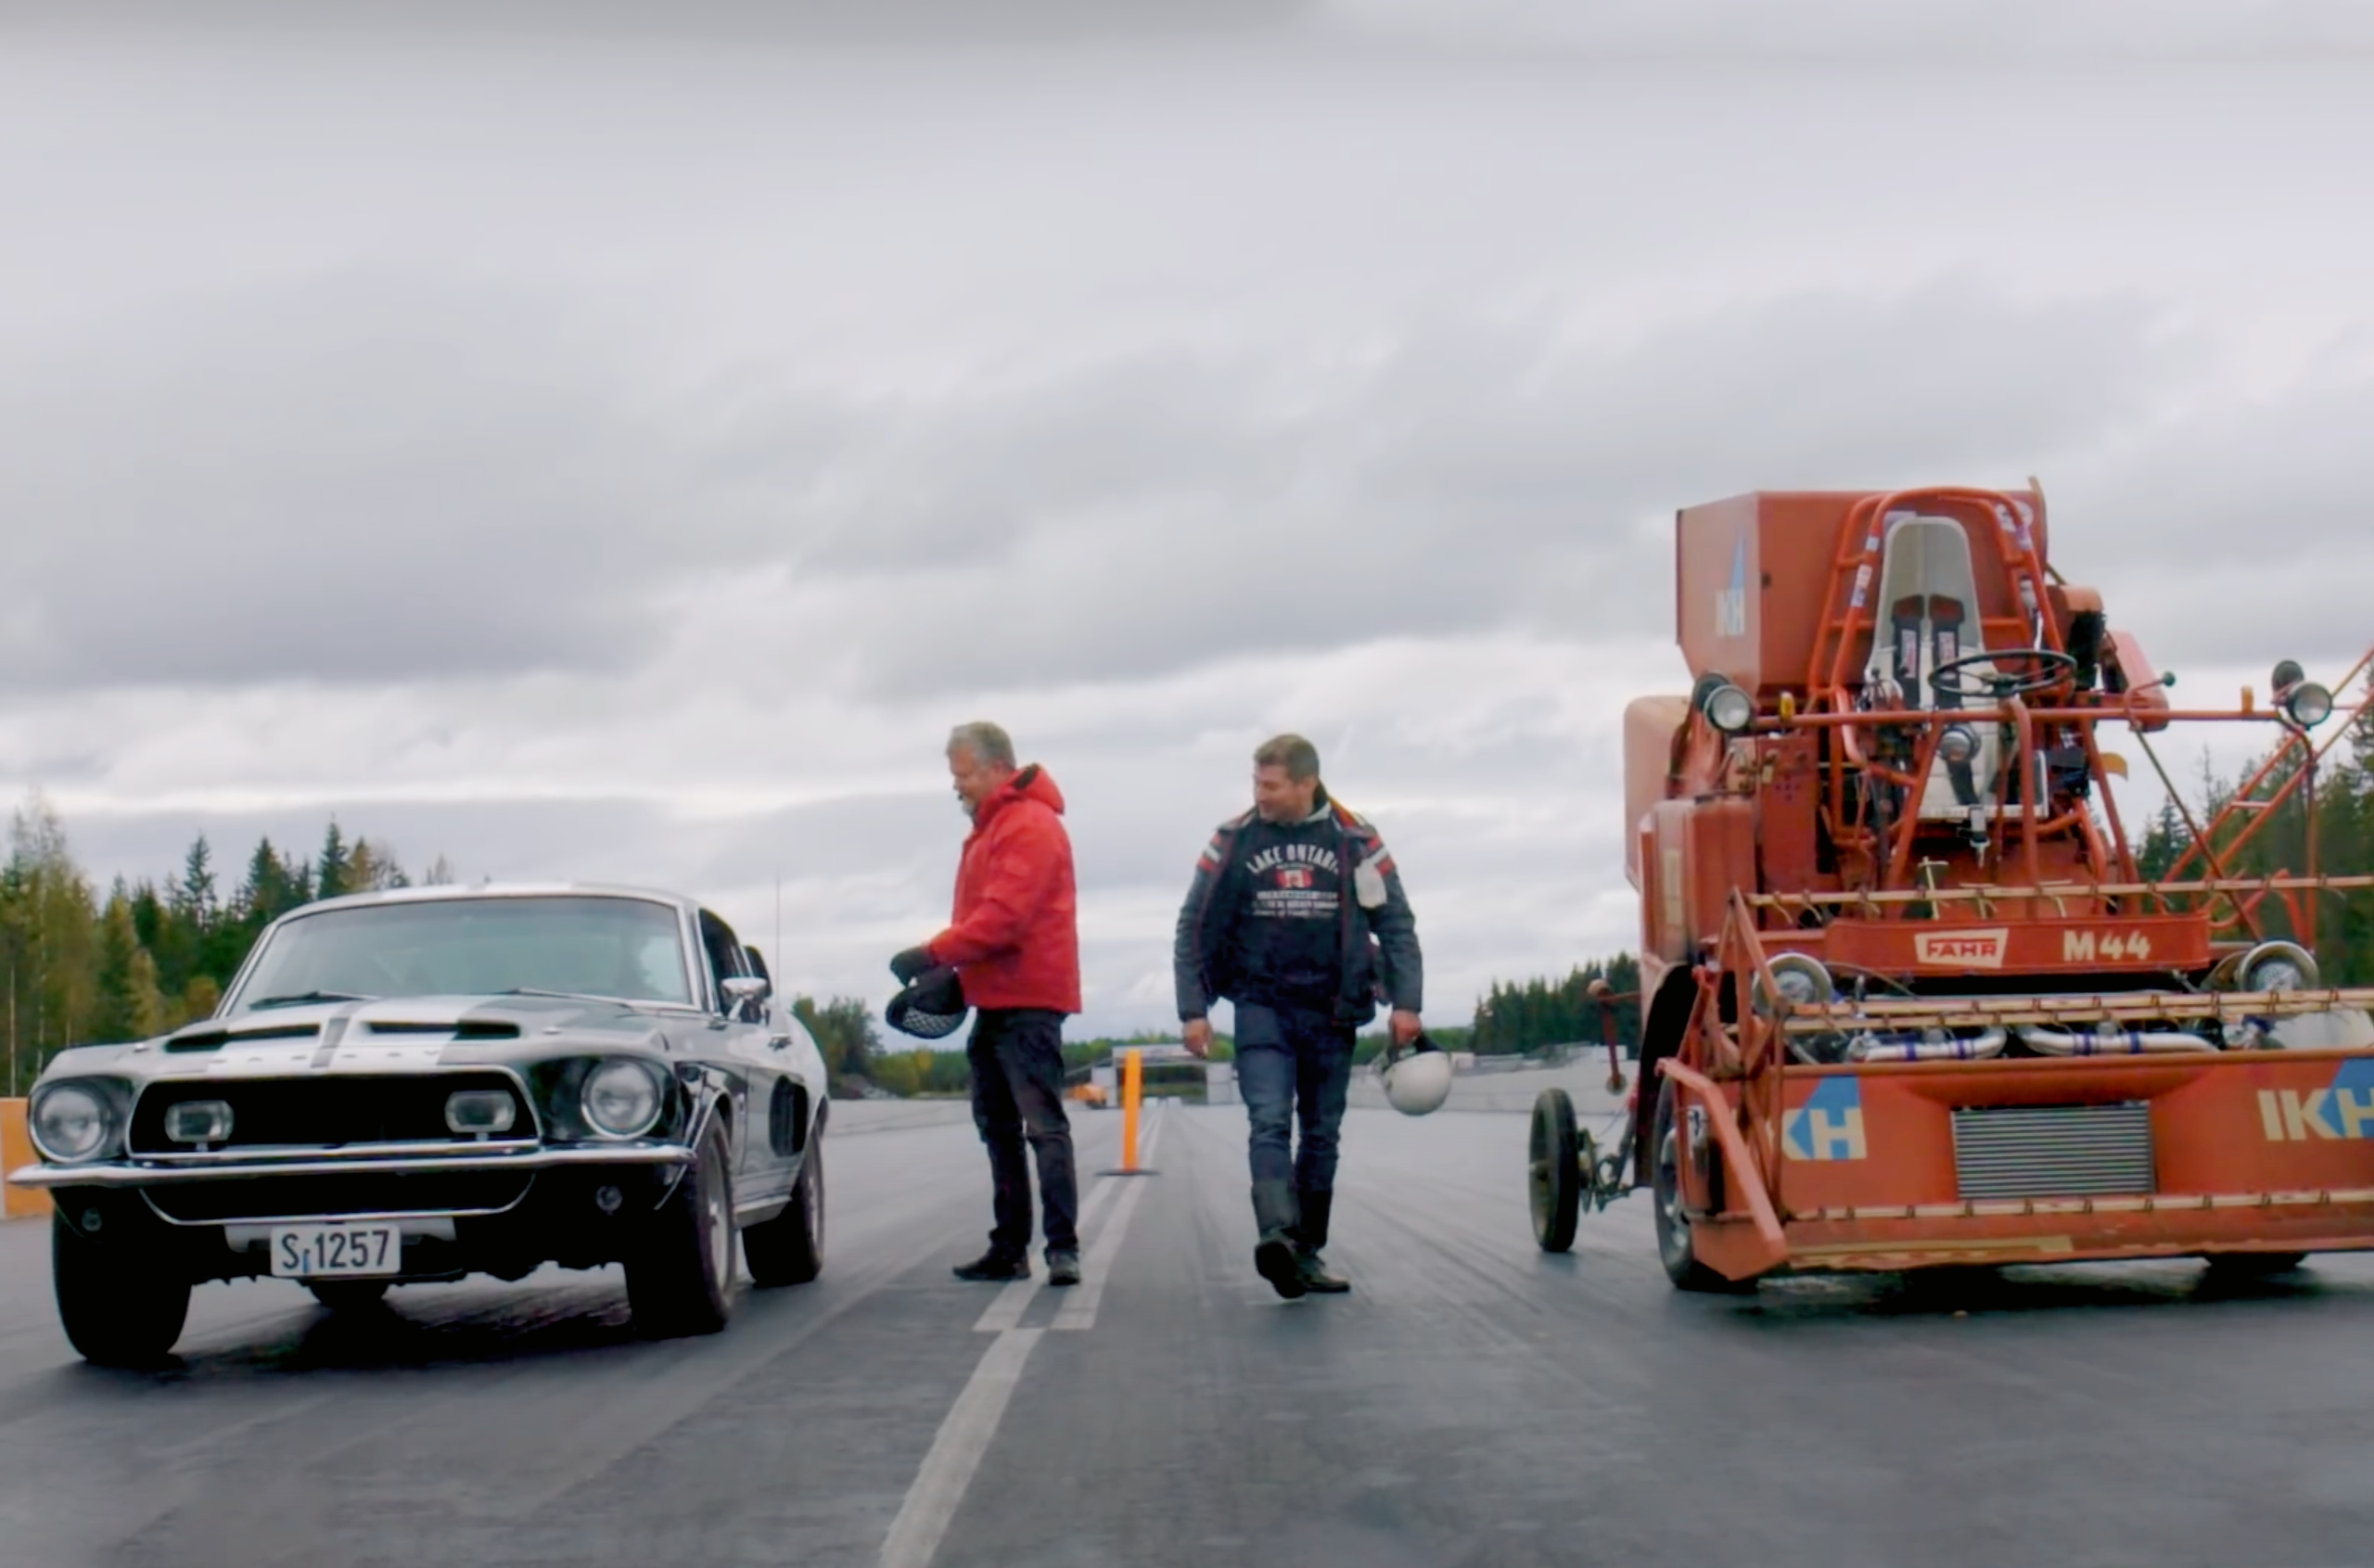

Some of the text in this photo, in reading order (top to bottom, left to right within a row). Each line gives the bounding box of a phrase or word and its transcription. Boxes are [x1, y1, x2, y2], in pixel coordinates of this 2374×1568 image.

[1245, 843, 1339, 875] LAKE ONTARI
[1926, 937, 1997, 958] FAHR
